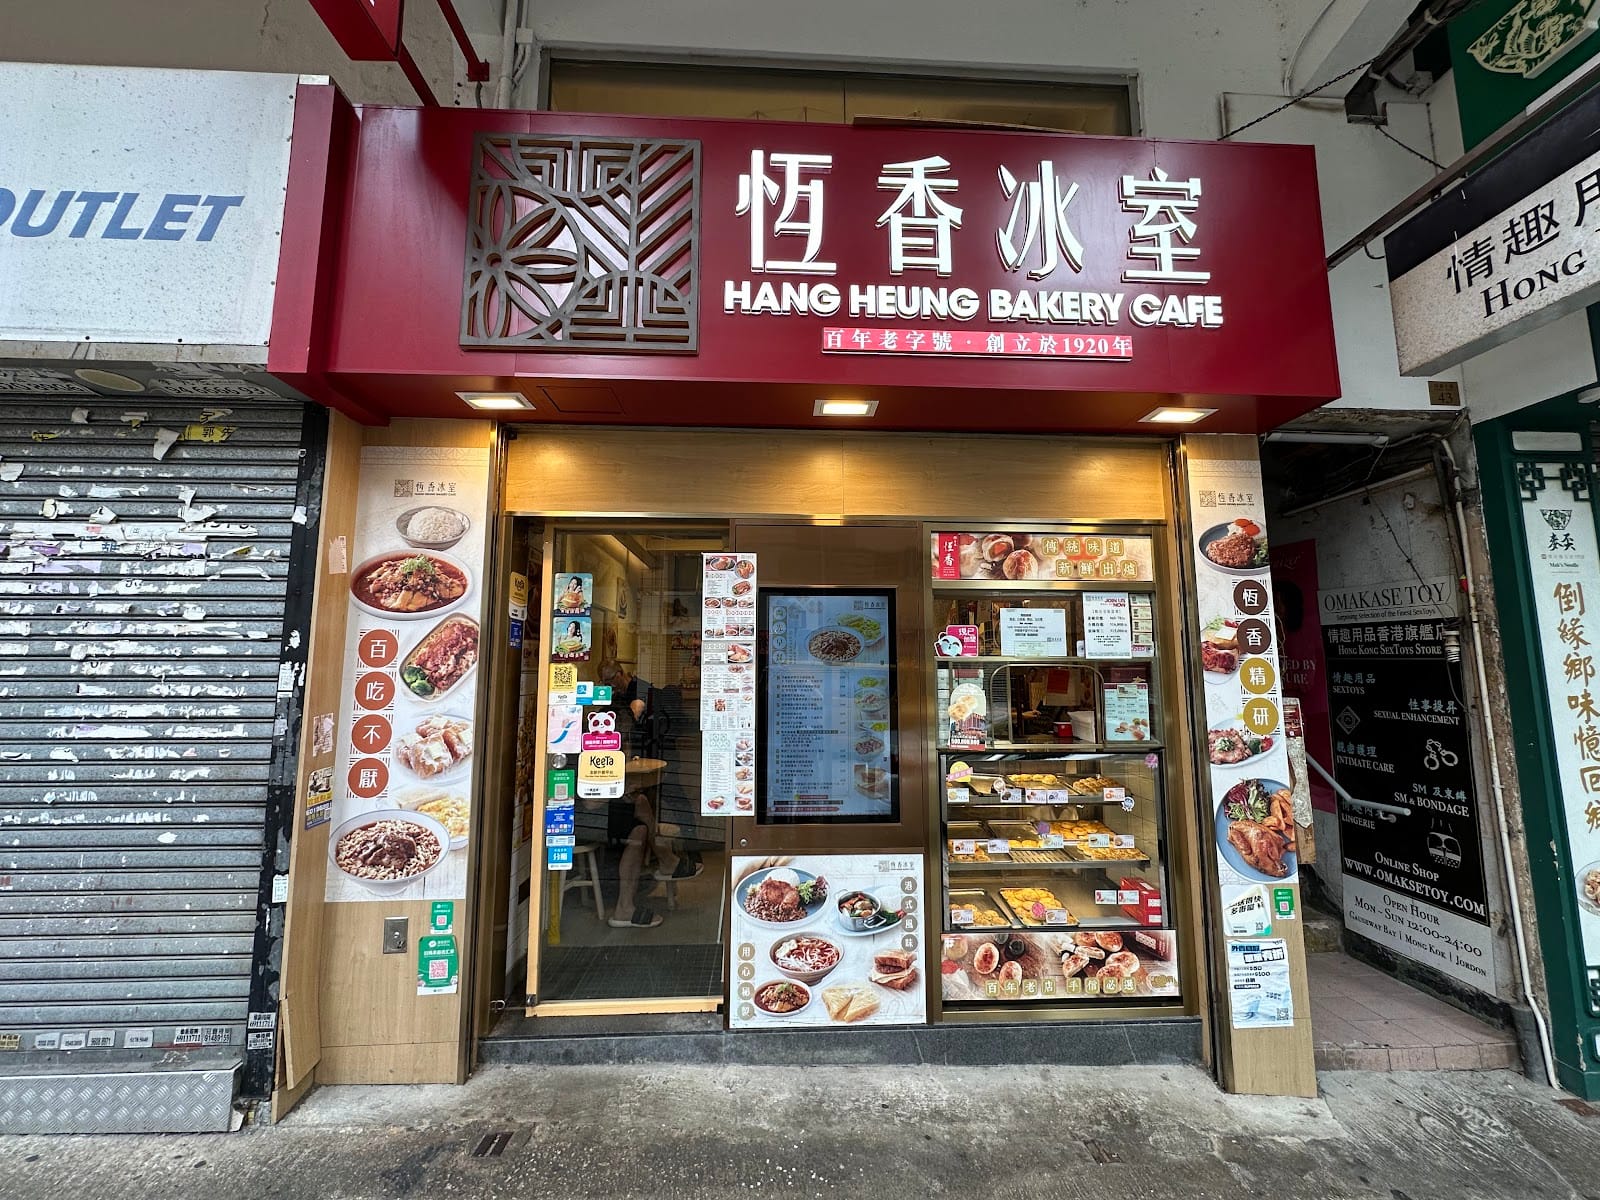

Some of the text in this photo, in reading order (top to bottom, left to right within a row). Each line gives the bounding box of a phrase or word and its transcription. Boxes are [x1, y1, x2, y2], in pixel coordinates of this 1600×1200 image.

[735, 148, 1211, 283] 恆香冰室
[723, 280, 1224, 328] HANG HEUNG BAKERY CAFE
[1324, 582, 1446, 612] OMAKASE TOY
[1332, 685, 1365, 695] SEXTOYS
[1373, 710, 1460, 726] SEXUAL ENHANCEMENT
[1372, 761, 1395, 774] CARE
[1412, 783, 1427, 795] SM
[1394, 791, 1408, 805] SM
[1417, 798, 1470, 818] BONDAGE
[1341, 812, 1376, 830] LINGERIE
[1343, 857, 1486, 917] WWW.OMAKSETOY.COM
